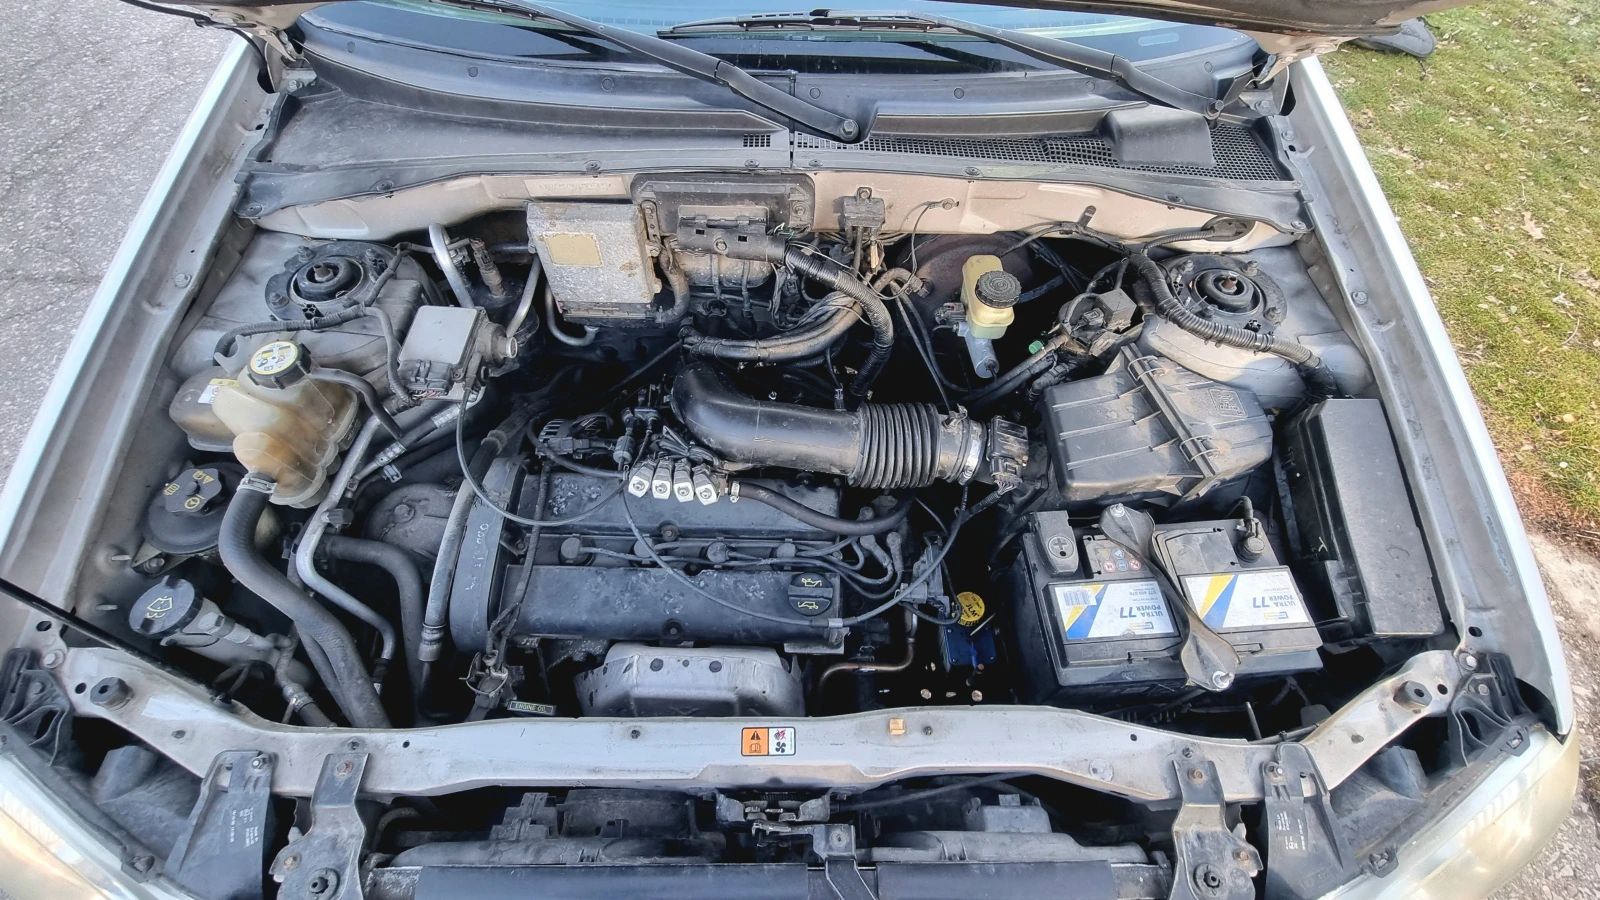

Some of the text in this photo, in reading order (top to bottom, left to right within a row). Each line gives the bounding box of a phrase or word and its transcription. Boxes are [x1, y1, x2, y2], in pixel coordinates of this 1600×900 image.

[1252, 596, 1270, 608] 77
[966, 604, 978, 617] JLM
[1120, 606, 1136, 618] 77
[515, 703, 536, 711] ENGINE
